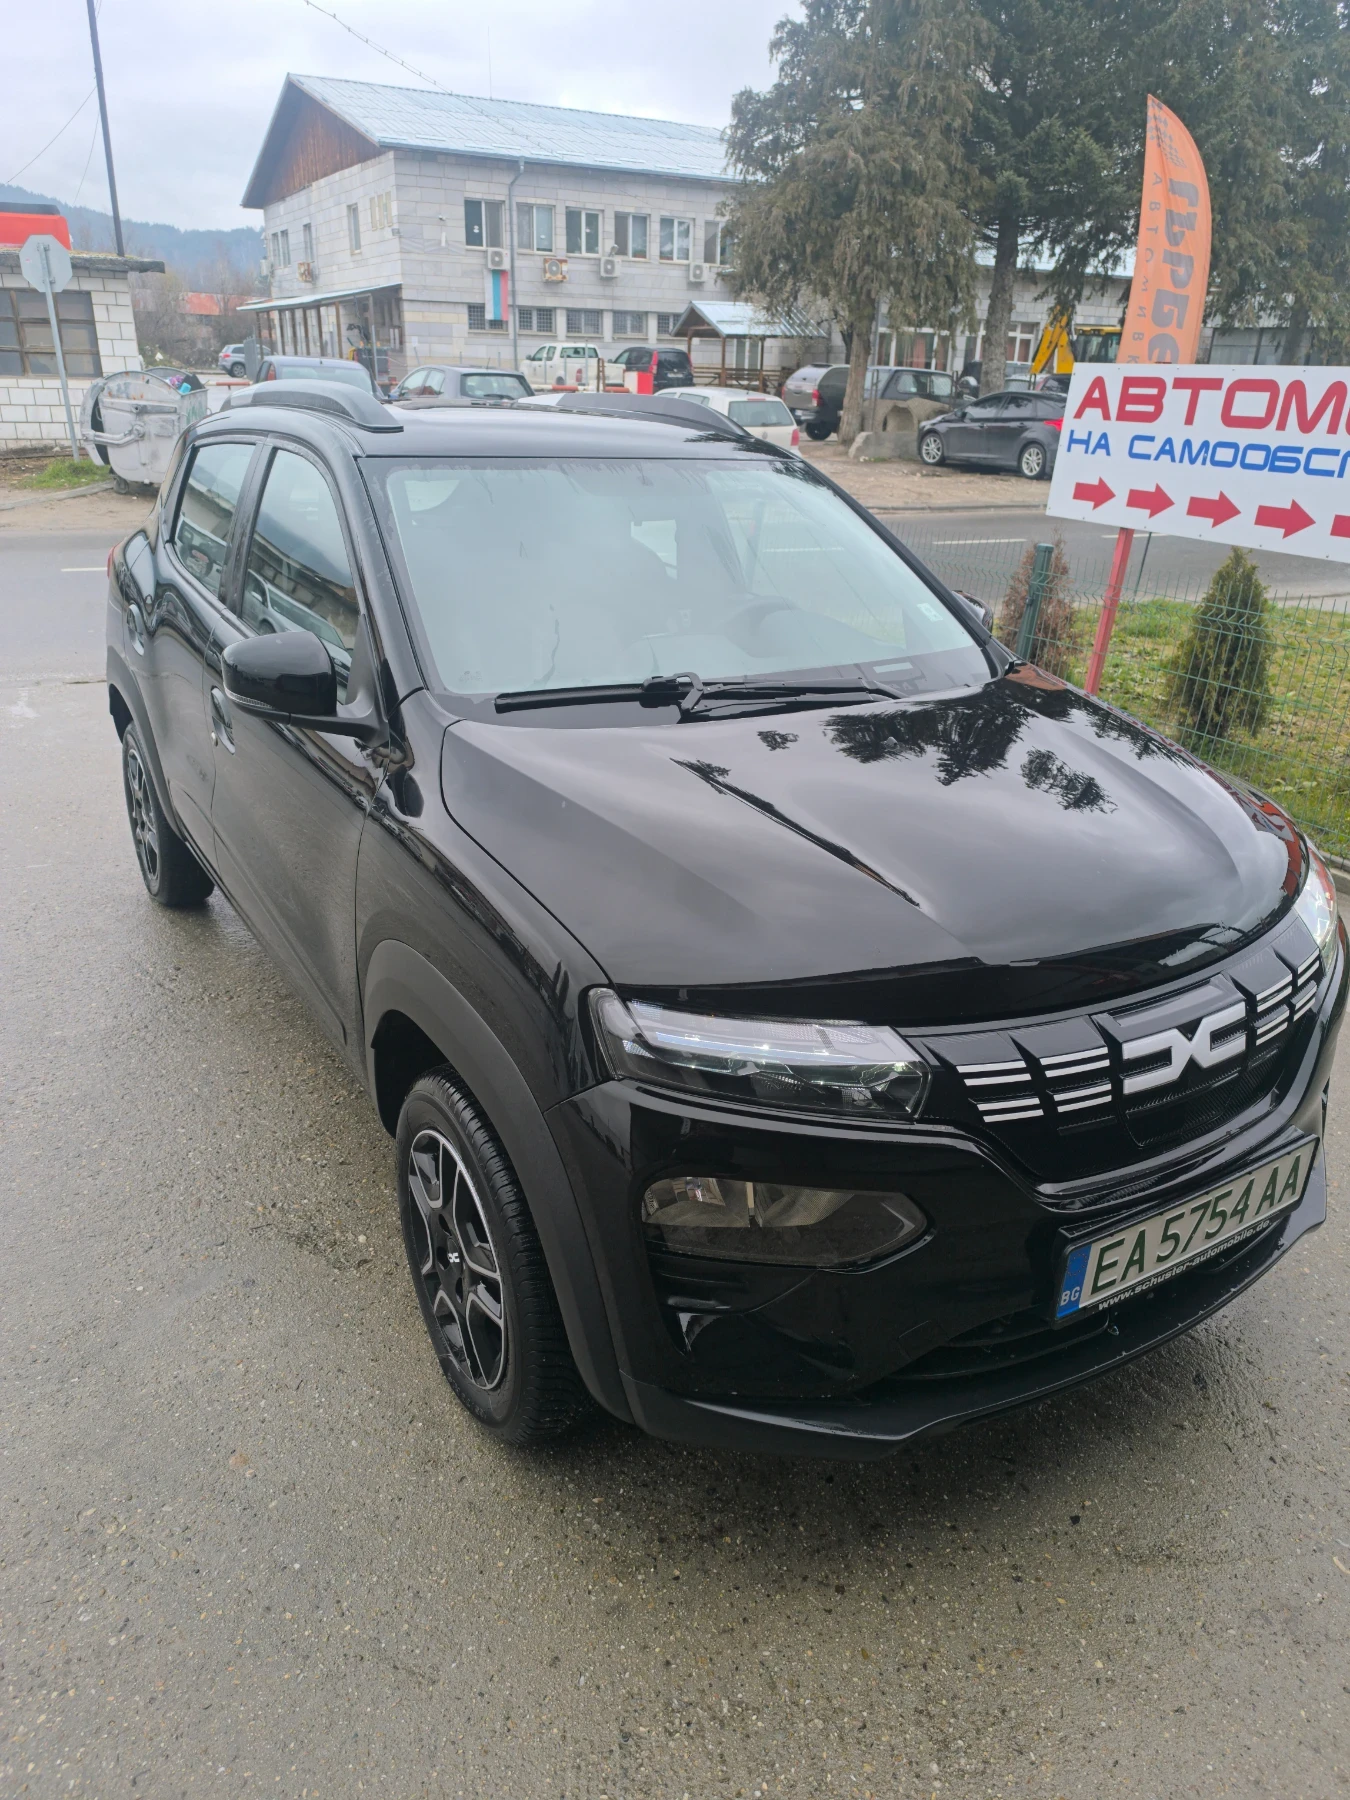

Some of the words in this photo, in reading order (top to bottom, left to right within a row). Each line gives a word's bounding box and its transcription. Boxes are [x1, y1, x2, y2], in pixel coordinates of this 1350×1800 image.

[1073, 375, 1350, 436] АВТОМ
[1066, 429, 1111, 457] НА
[1090, 1229, 1147, 1295] EA
[1156, 1178, 1256, 1263] 5754
[1254, 1153, 1302, 1216] AA
[1060, 1286, 1081, 1307] BG
